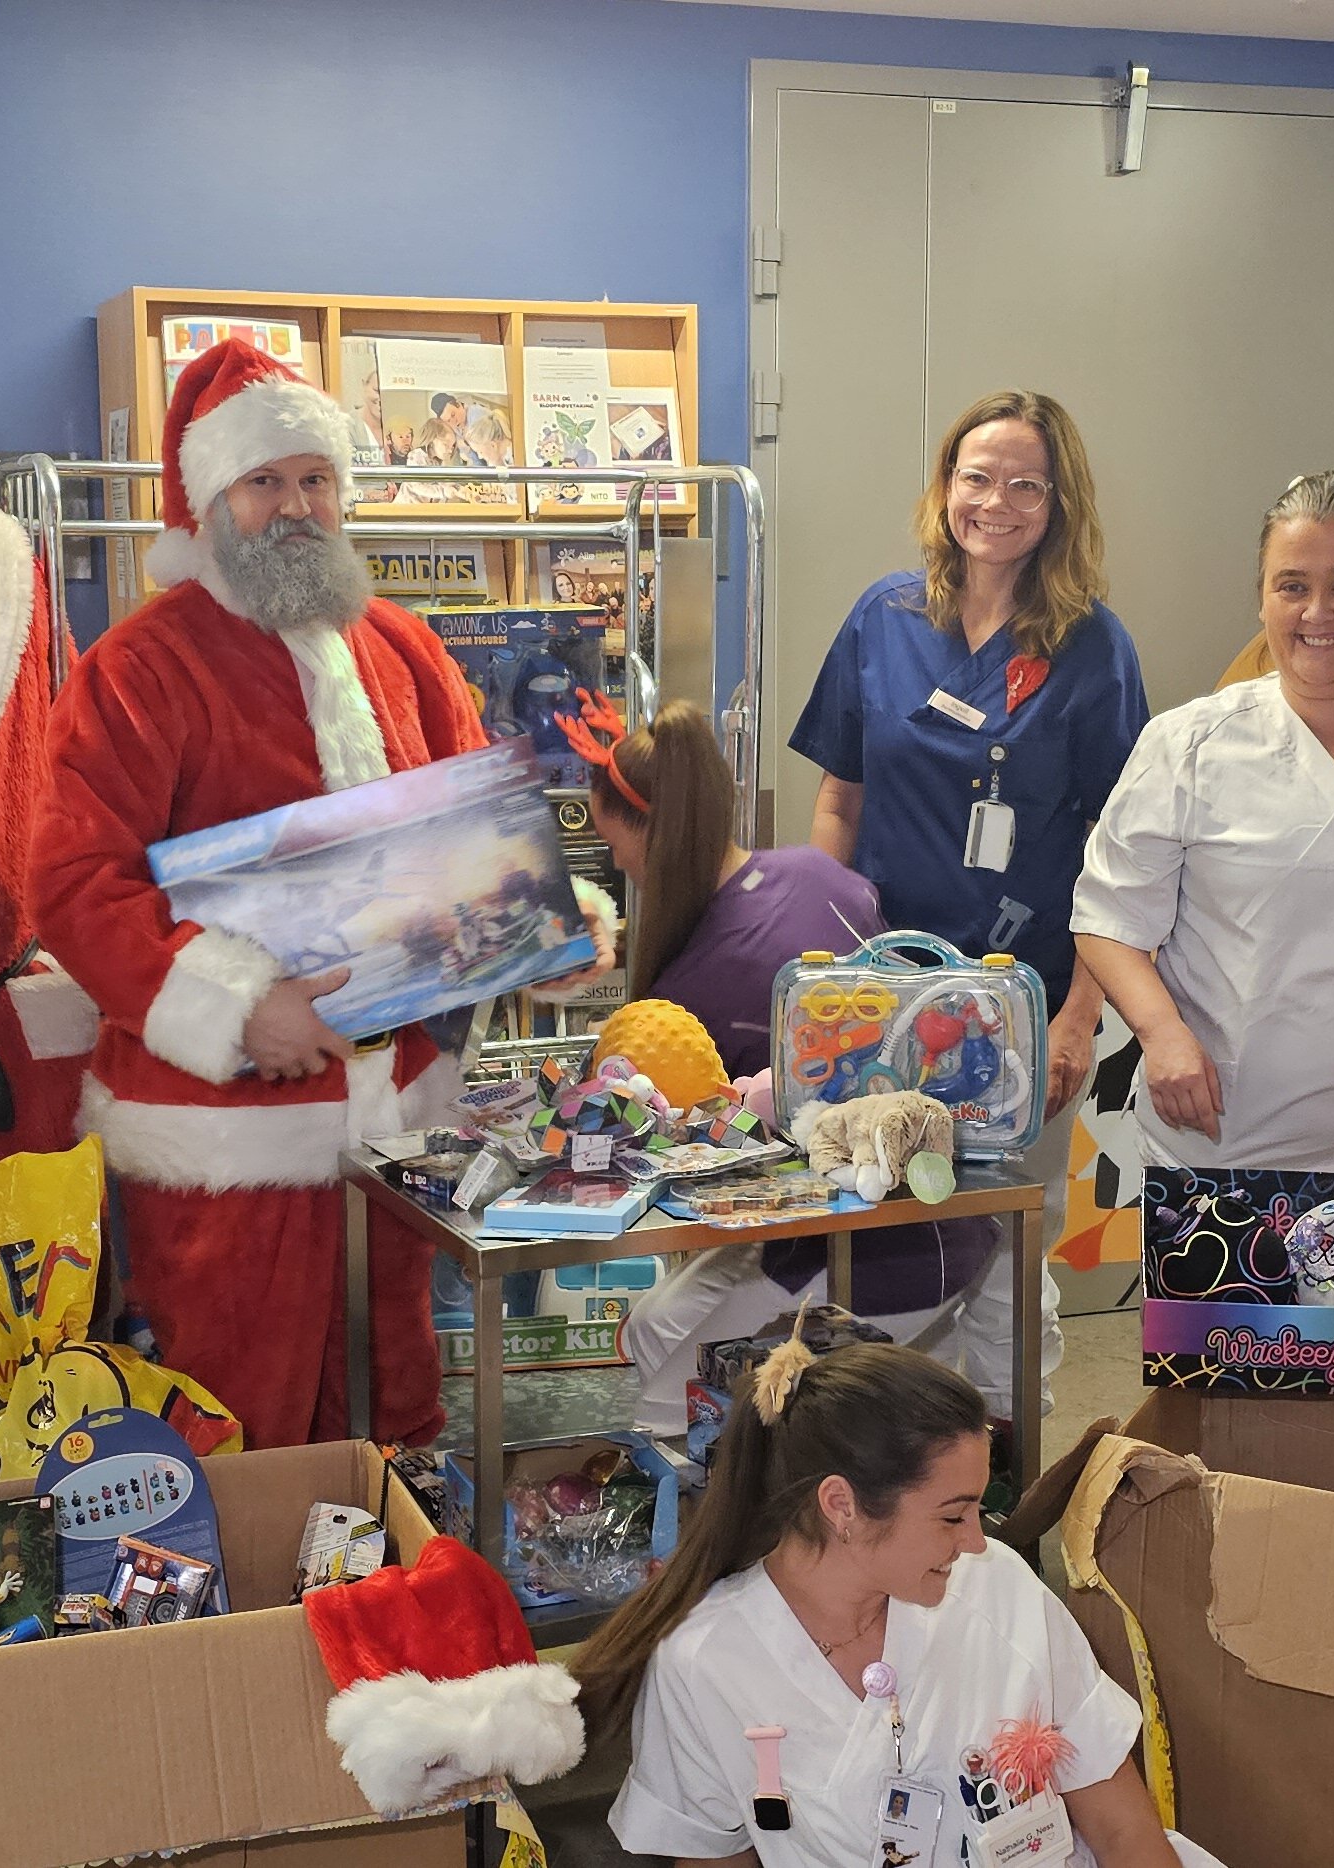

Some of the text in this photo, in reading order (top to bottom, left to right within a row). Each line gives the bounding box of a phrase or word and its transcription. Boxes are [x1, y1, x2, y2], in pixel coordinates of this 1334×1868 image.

[392, 376, 415, 385] 2023
[533, 394, 560, 402] BARN
[367, 559, 474, 584] PAIDOS
[440, 615, 508, 635] AMONG US
[442, 635, 508, 646] ACTION FIGURES
[564, 1328, 613, 1351] Kit
[67, 1435, 84, 1448] 16
[995, 1838, 1025, 1857] Nathalie
